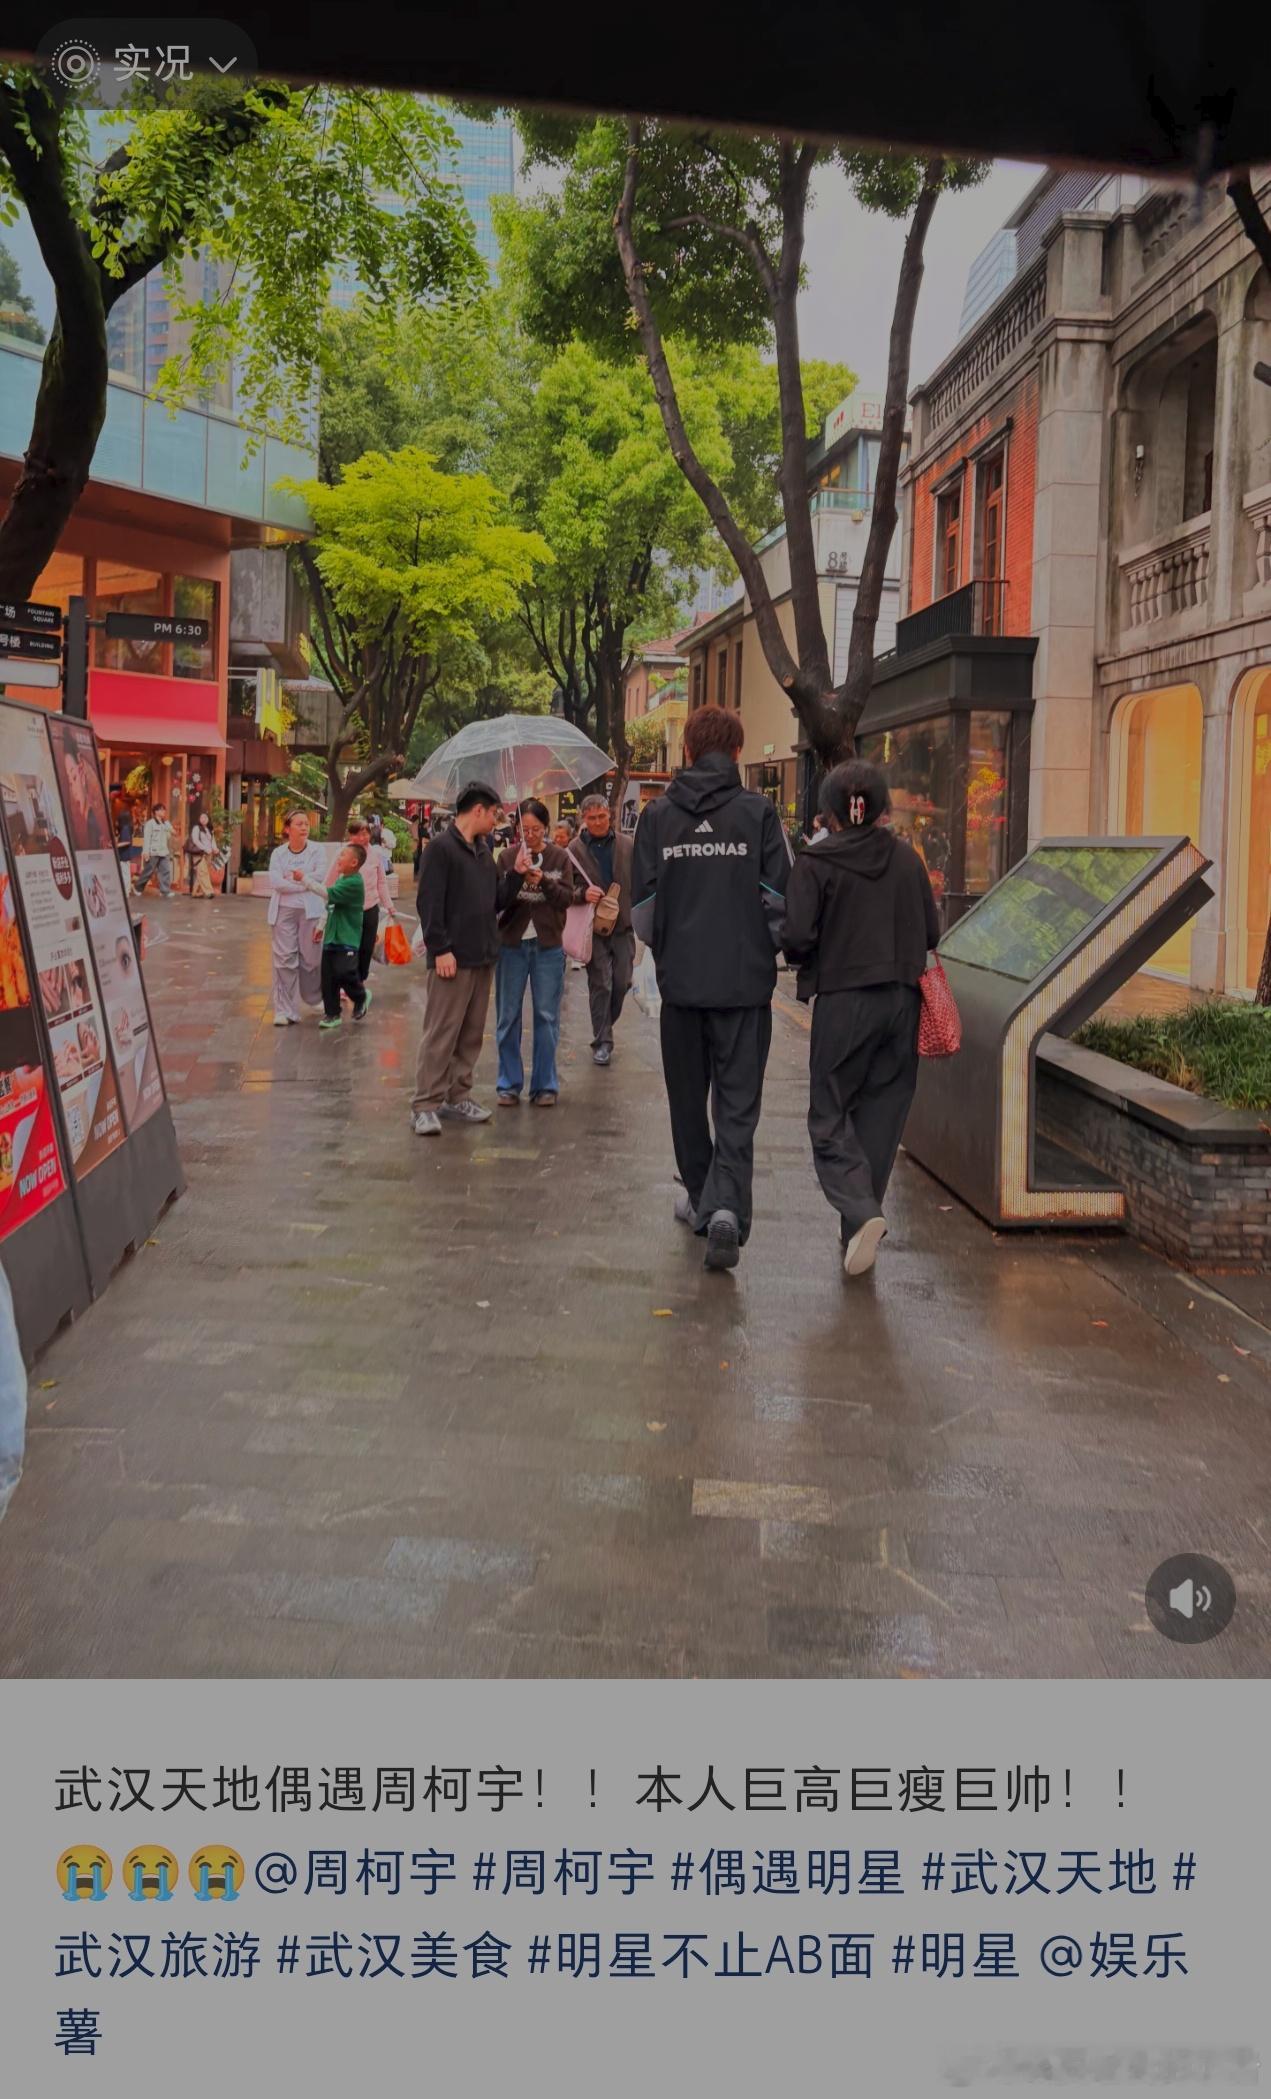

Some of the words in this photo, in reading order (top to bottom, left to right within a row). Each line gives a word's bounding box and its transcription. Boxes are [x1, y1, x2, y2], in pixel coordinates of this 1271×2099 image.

[27, 608, 55, 617] FOUNTAIN
[33, 616, 54, 624] SQUARE
[154, 622, 172, 633] PM
[175, 624, 202, 636] 6:30
[662, 842, 748, 860] PETRONAS
[19, 1168, 38, 1199] NOW
[38, 1156, 57, 1184] OPEN
